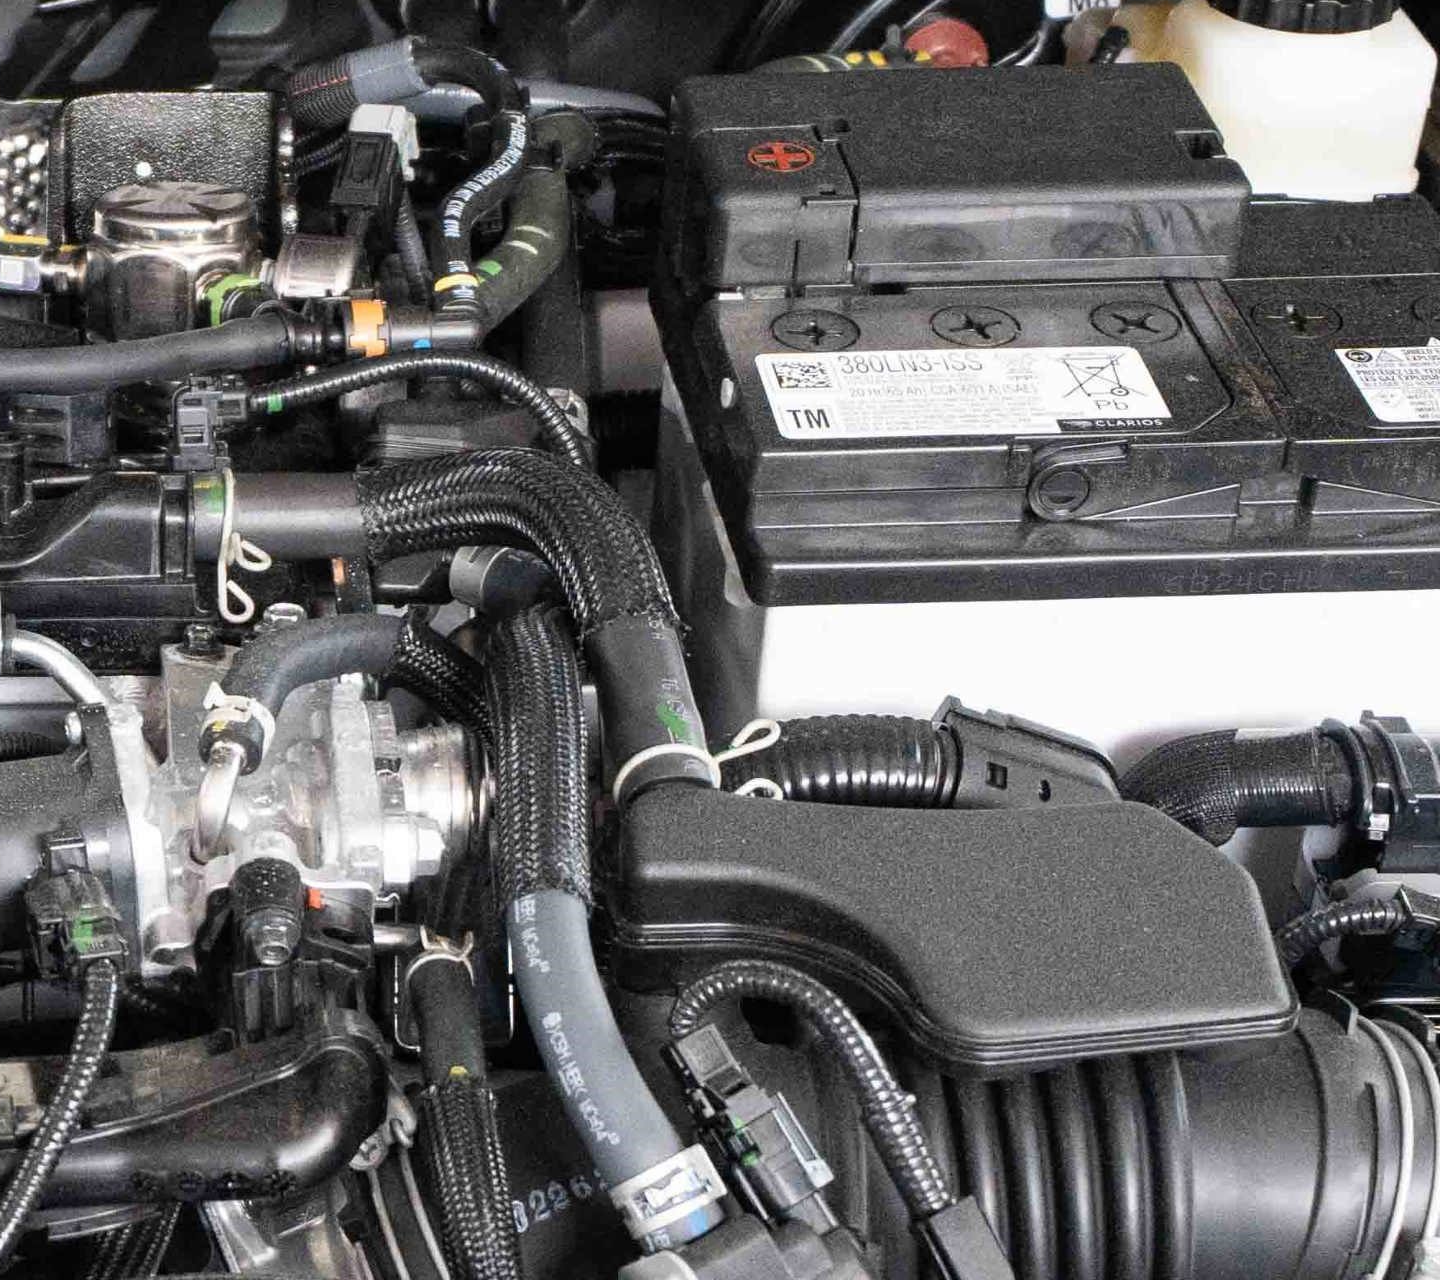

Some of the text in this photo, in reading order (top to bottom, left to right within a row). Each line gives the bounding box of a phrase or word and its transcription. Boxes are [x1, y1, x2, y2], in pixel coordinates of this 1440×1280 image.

[1094, 399, 1129, 411] Pb
[787, 408, 831, 429] TM
[1095, 420, 1163, 428] CLARIOS
